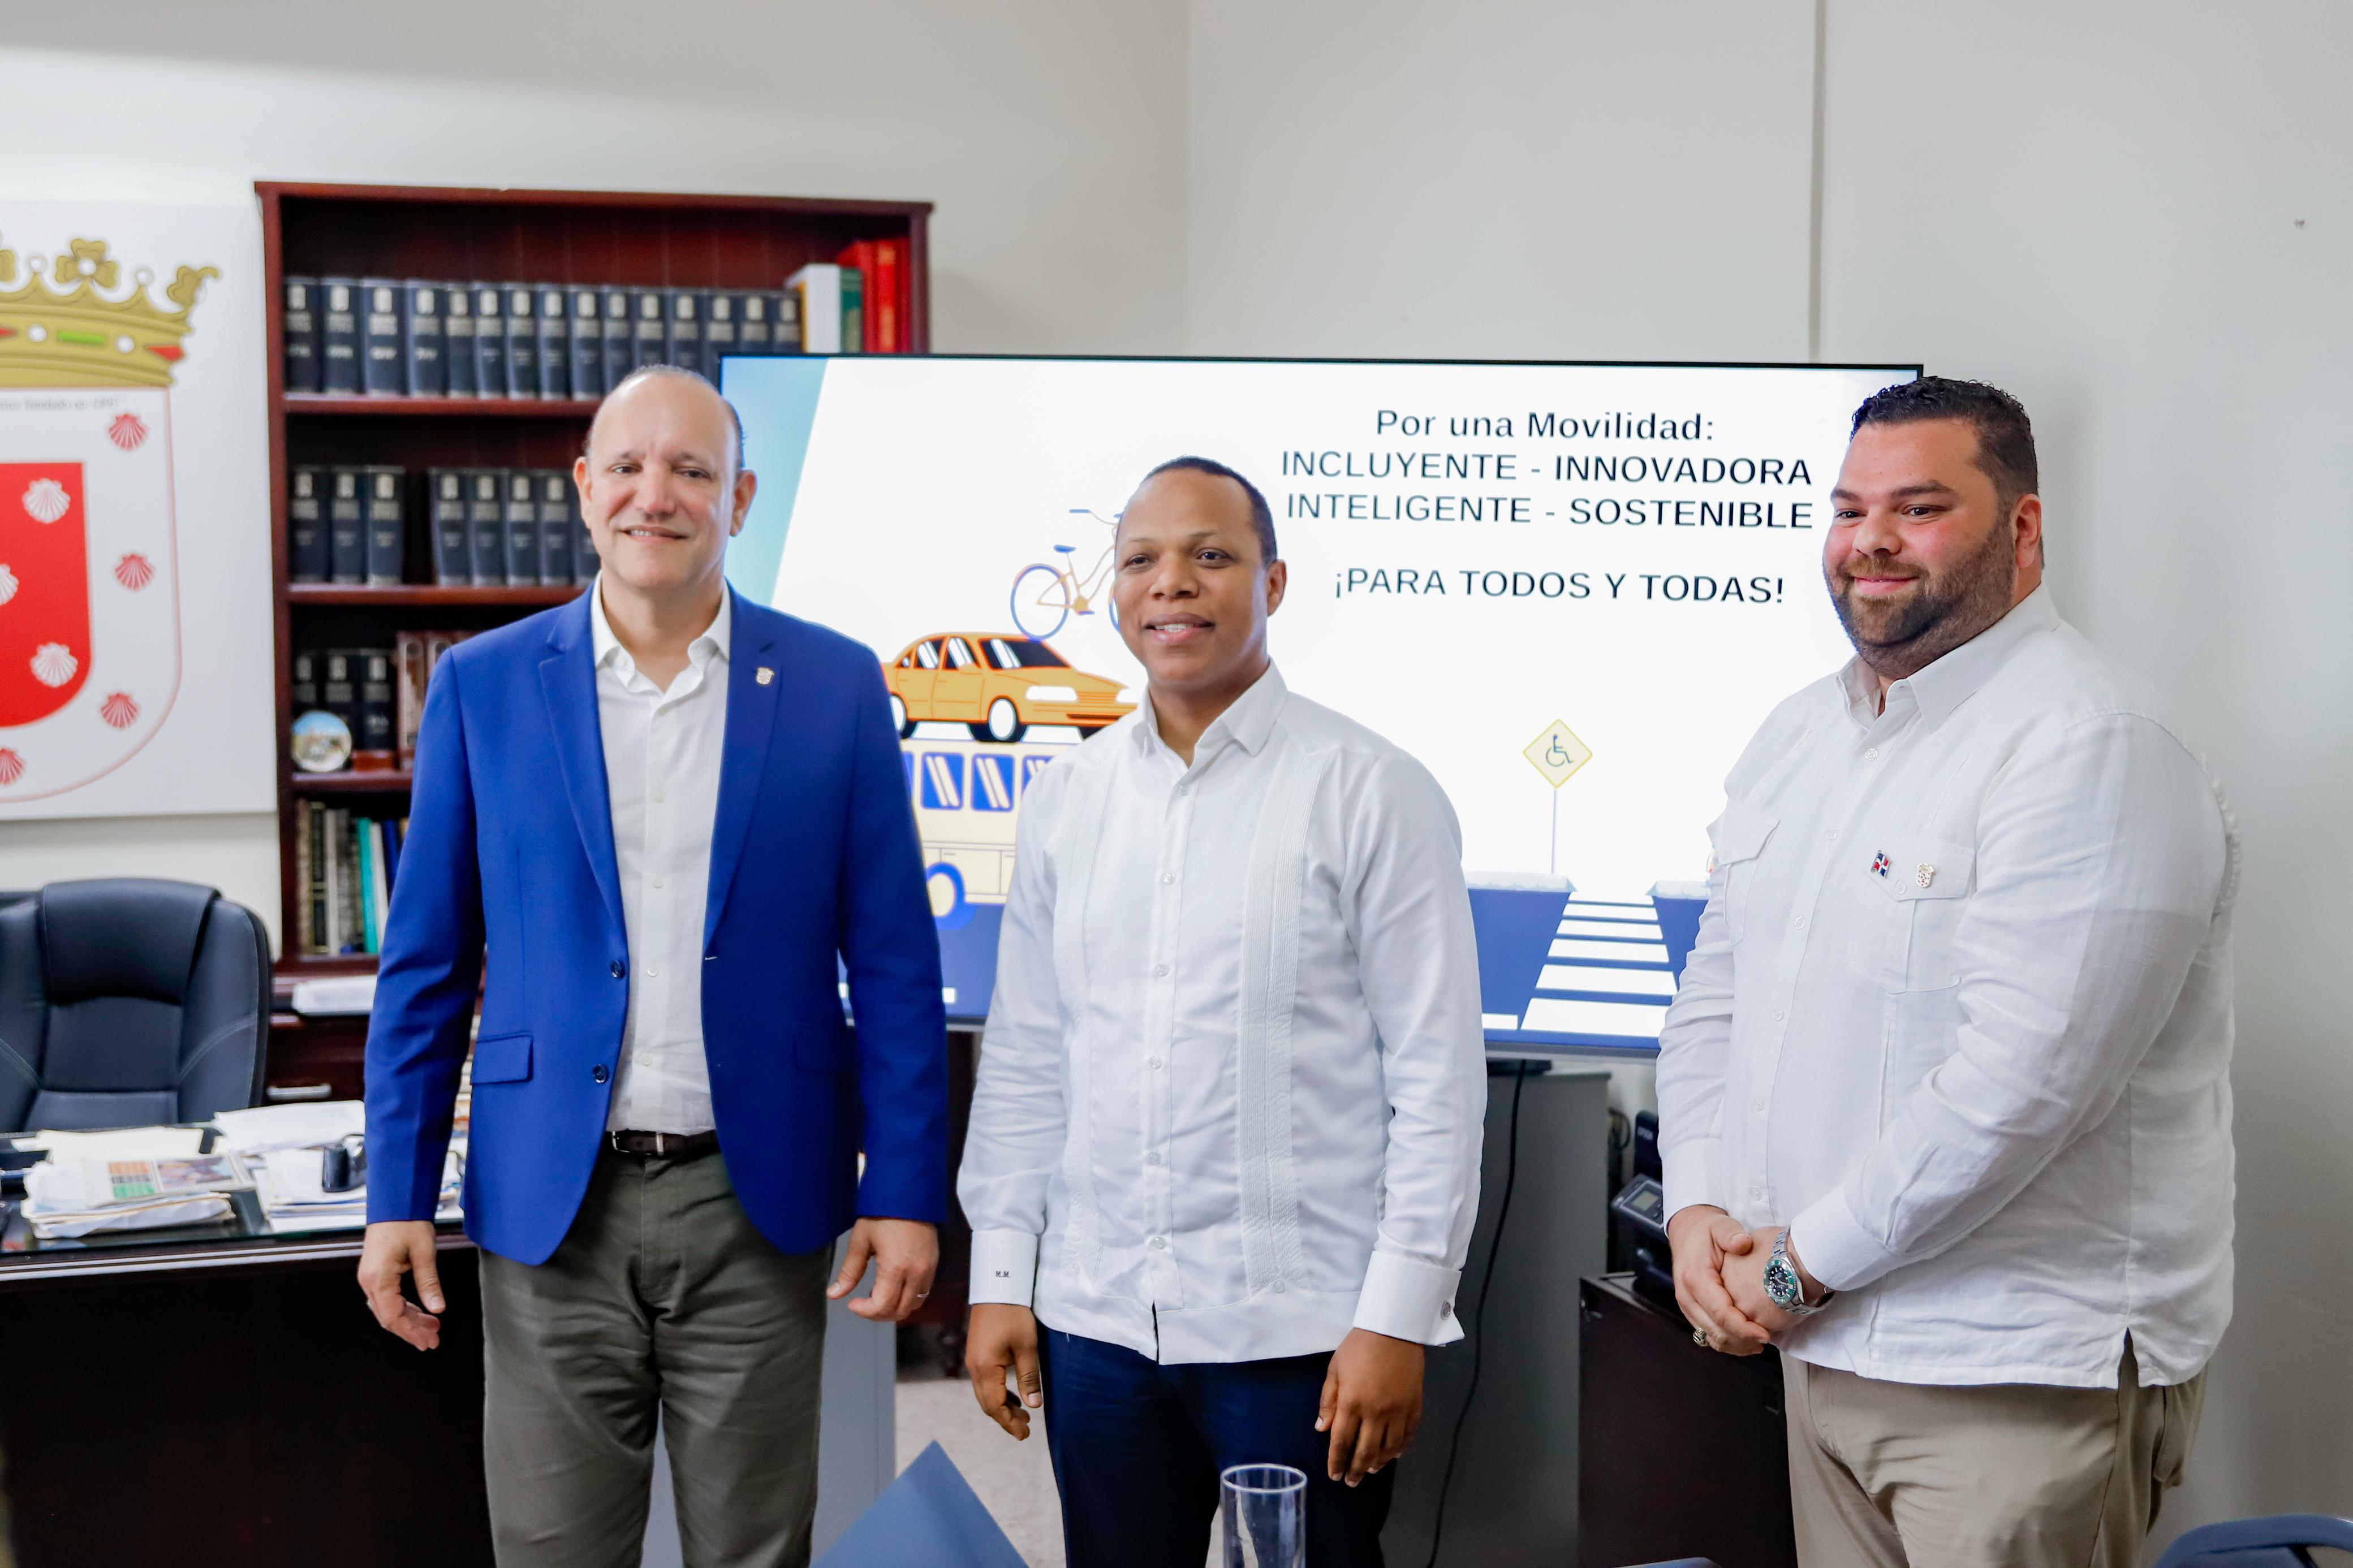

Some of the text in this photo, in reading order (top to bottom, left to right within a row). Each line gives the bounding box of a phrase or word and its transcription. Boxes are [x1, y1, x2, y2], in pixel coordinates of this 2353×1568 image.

[1377, 410, 1713, 440] Por una Movilidad:
[1283, 451, 1516, 480] INCLUYENTE
[1556, 455, 1812, 486] INNOVADORA
[1288, 494, 1531, 523] INTELIGENTE
[1570, 498, 1813, 529] SOSTENIBLE
[1336, 568, 1783, 604] ¡PARA TODOS Y TODAS!
